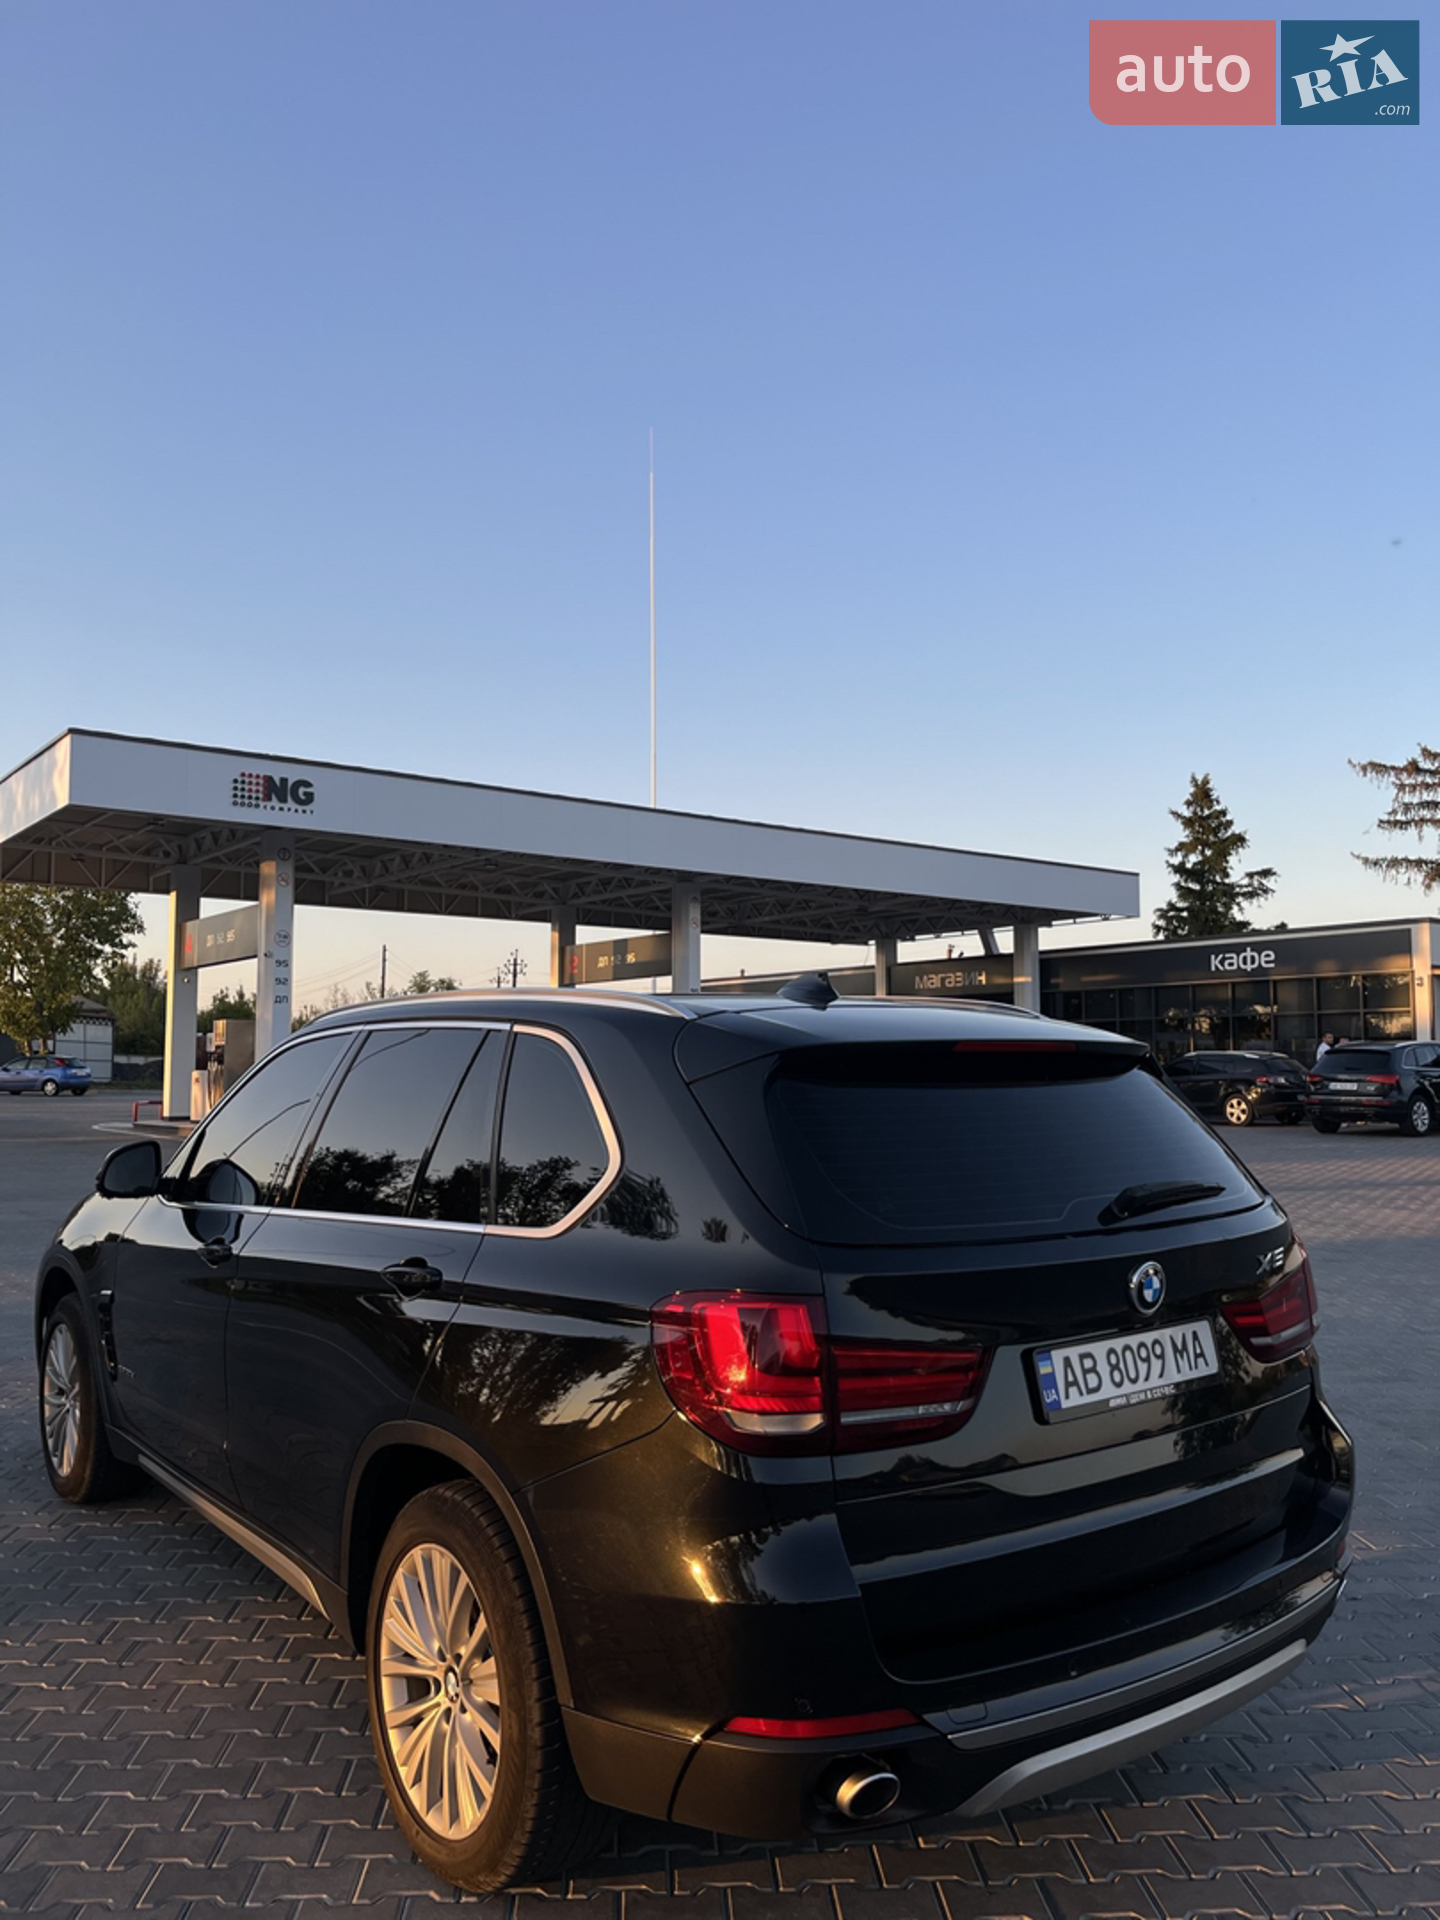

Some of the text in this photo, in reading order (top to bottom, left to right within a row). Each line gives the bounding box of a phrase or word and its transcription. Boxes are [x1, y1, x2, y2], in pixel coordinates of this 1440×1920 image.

[263, 804, 314, 815] COMPANY
[274, 959, 290, 968] 95
[1210, 947, 1276, 971] кафе
[274, 977, 290, 986] 92
[914, 970, 987, 990] магазин
[274, 994, 290, 1005] ДП
[1062, 1351, 1103, 1401] AB
[1106, 1338, 1166, 1389] 8099
[1169, 1329, 1210, 1375] MA
[1043, 1389, 1059, 1404] UA
